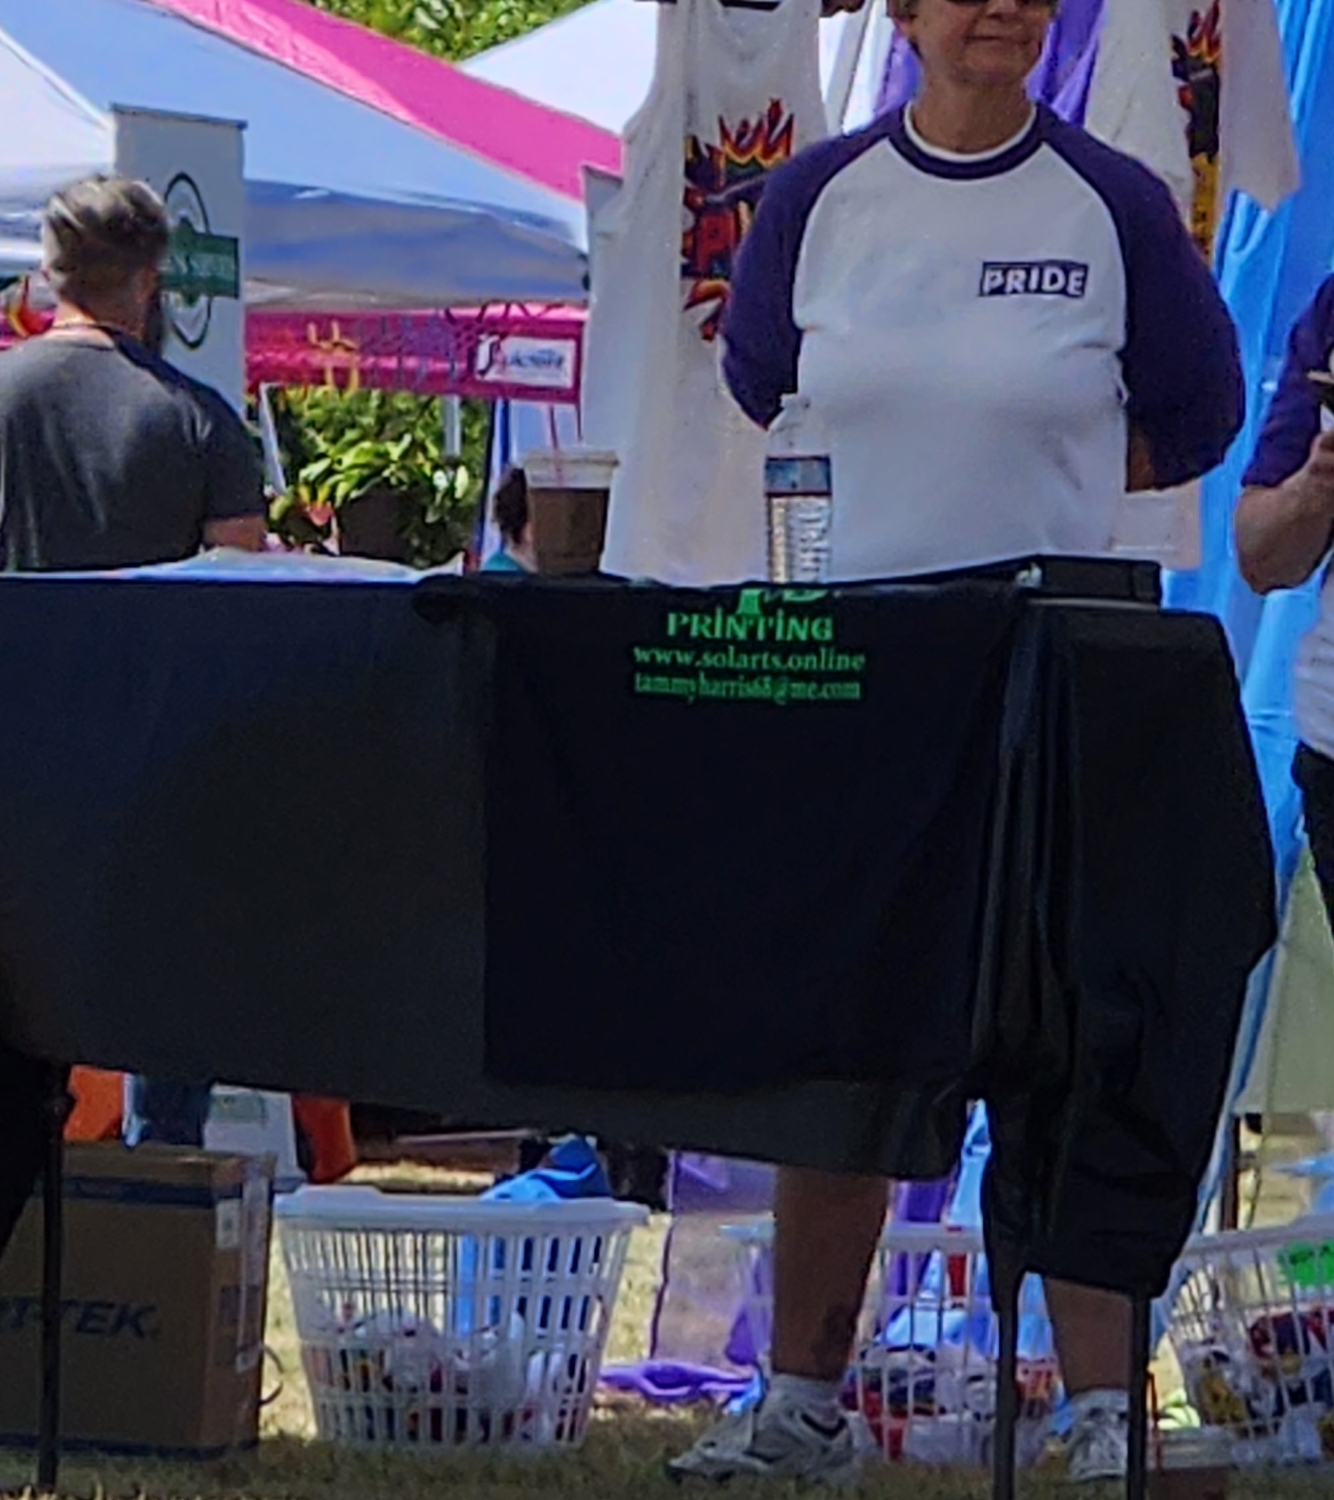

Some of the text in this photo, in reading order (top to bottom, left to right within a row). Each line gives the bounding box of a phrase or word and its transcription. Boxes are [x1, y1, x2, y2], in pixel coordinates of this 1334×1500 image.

[982, 265, 1086, 296] PRIDE
[667, 607, 834, 641] PRINTING
[633, 645, 866, 672] www.solarts.online
